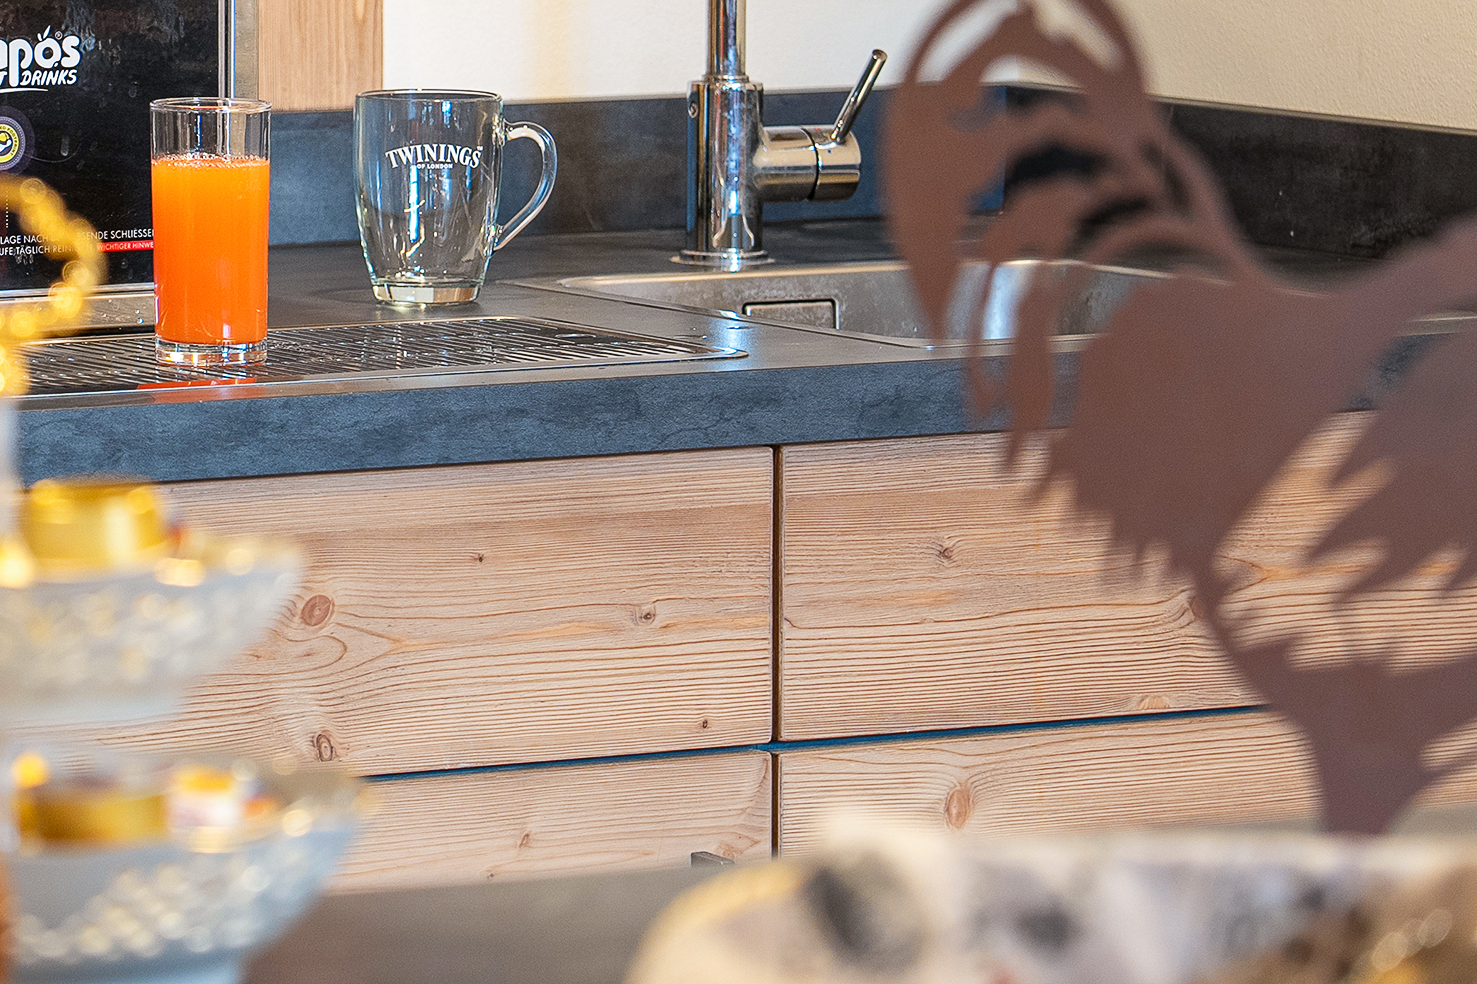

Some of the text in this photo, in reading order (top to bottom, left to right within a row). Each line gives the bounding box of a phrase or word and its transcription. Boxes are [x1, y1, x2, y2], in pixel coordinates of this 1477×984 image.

[20, 69, 78, 86] DRINKS
[385, 143, 482, 169] TWININGS
[24, 233, 49, 244] NACH
[15, 244, 50, 256] TÄGLICH
[97, 242, 131, 250] WICHTIGER
[132, 241, 154, 249] HINWE
